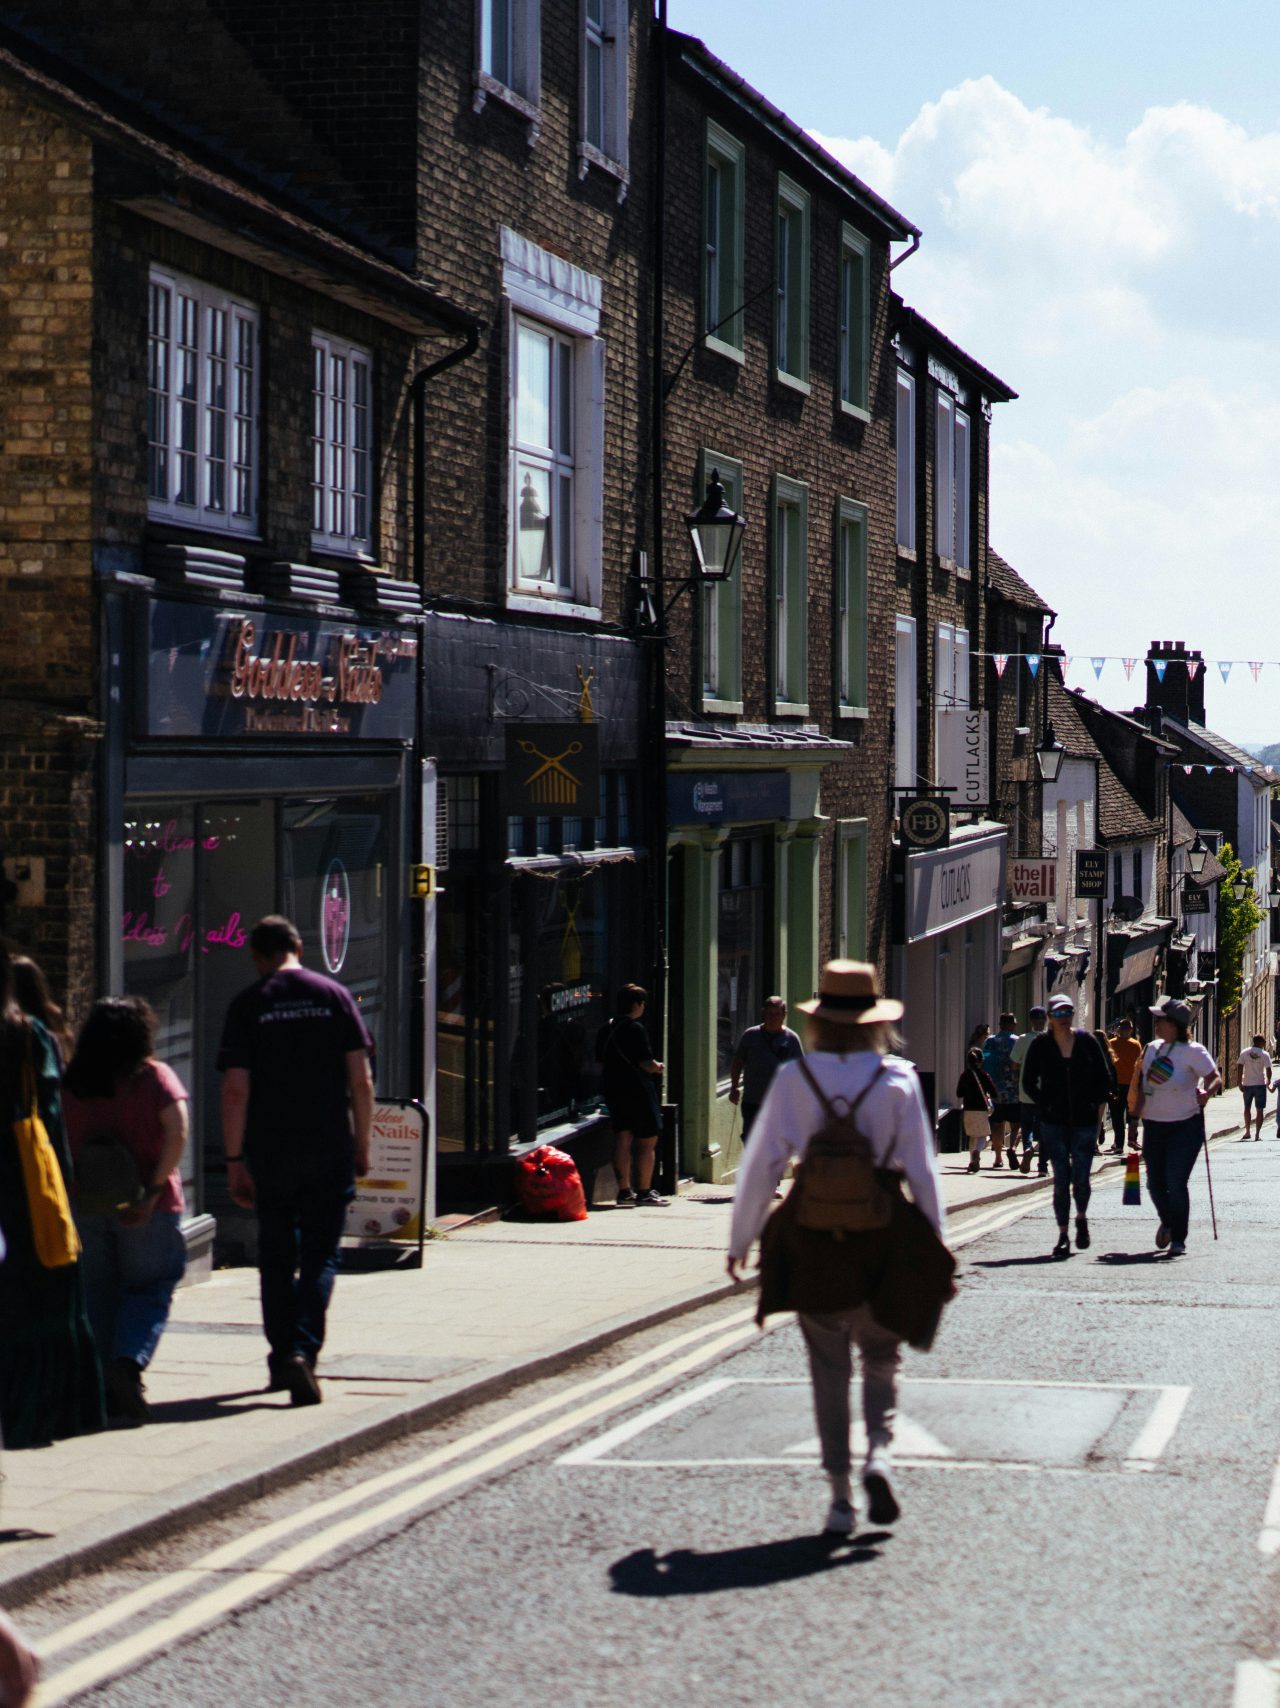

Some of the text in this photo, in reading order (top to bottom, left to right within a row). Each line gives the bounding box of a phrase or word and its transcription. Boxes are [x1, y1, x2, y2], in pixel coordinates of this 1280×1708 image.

[965, 714, 980, 802] CUTLACKS
[1013, 864, 1040, 881] the
[1079, 870, 1105, 878] STAMP
[1085, 860, 1099, 868] ELY
[152, 866, 172, 897] to
[940, 863, 971, 909] CUTLACKS
[1013, 864, 1055, 897] wall
[372, 1125, 420, 1140] Nails
